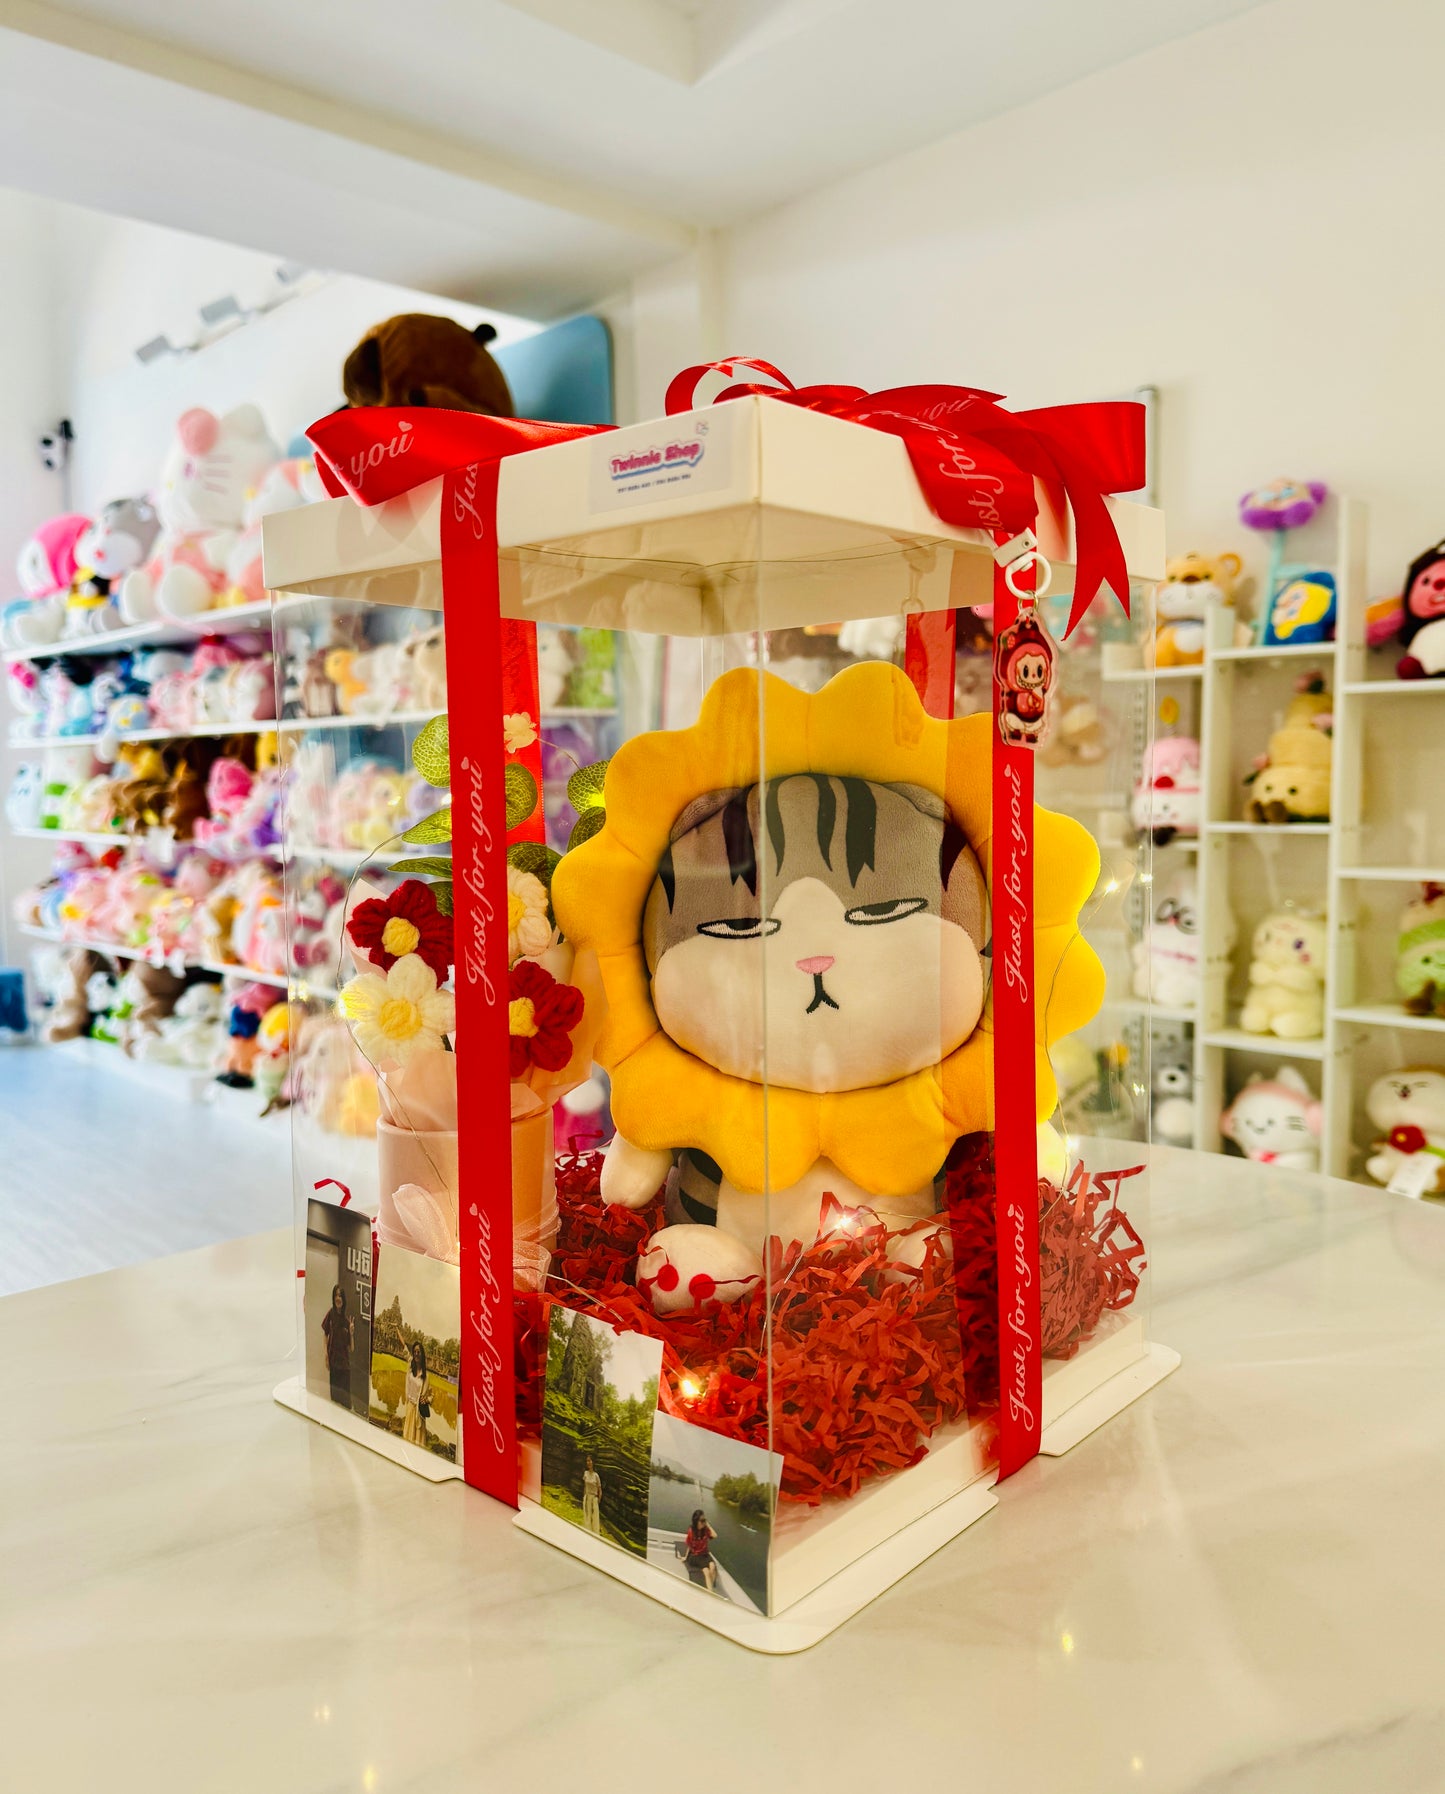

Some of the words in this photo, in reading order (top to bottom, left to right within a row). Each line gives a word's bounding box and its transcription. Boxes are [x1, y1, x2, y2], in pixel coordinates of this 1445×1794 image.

[350, 432, 415, 490] you
[665, 443, 700, 461] Shop
[939, 435, 1004, 495] for
[454, 462, 484, 540] Jus
[968, 490, 1005, 531] ust
[470, 760, 493, 853] you
[1010, 768, 1027, 857] you
[462, 842, 494, 922] for
[1003, 846, 1027, 923] for
[464, 904, 496, 1006] Just
[1004, 910, 1028, 1004] Just
[478, 1209, 501, 1304] you
[1014, 1205, 1032, 1288] you
[470, 1287, 502, 1372] for
[1008, 1282, 1033, 1352] for
[472, 1351, 505, 1454] Just
[1008, 1343, 1034, 1432] Just
